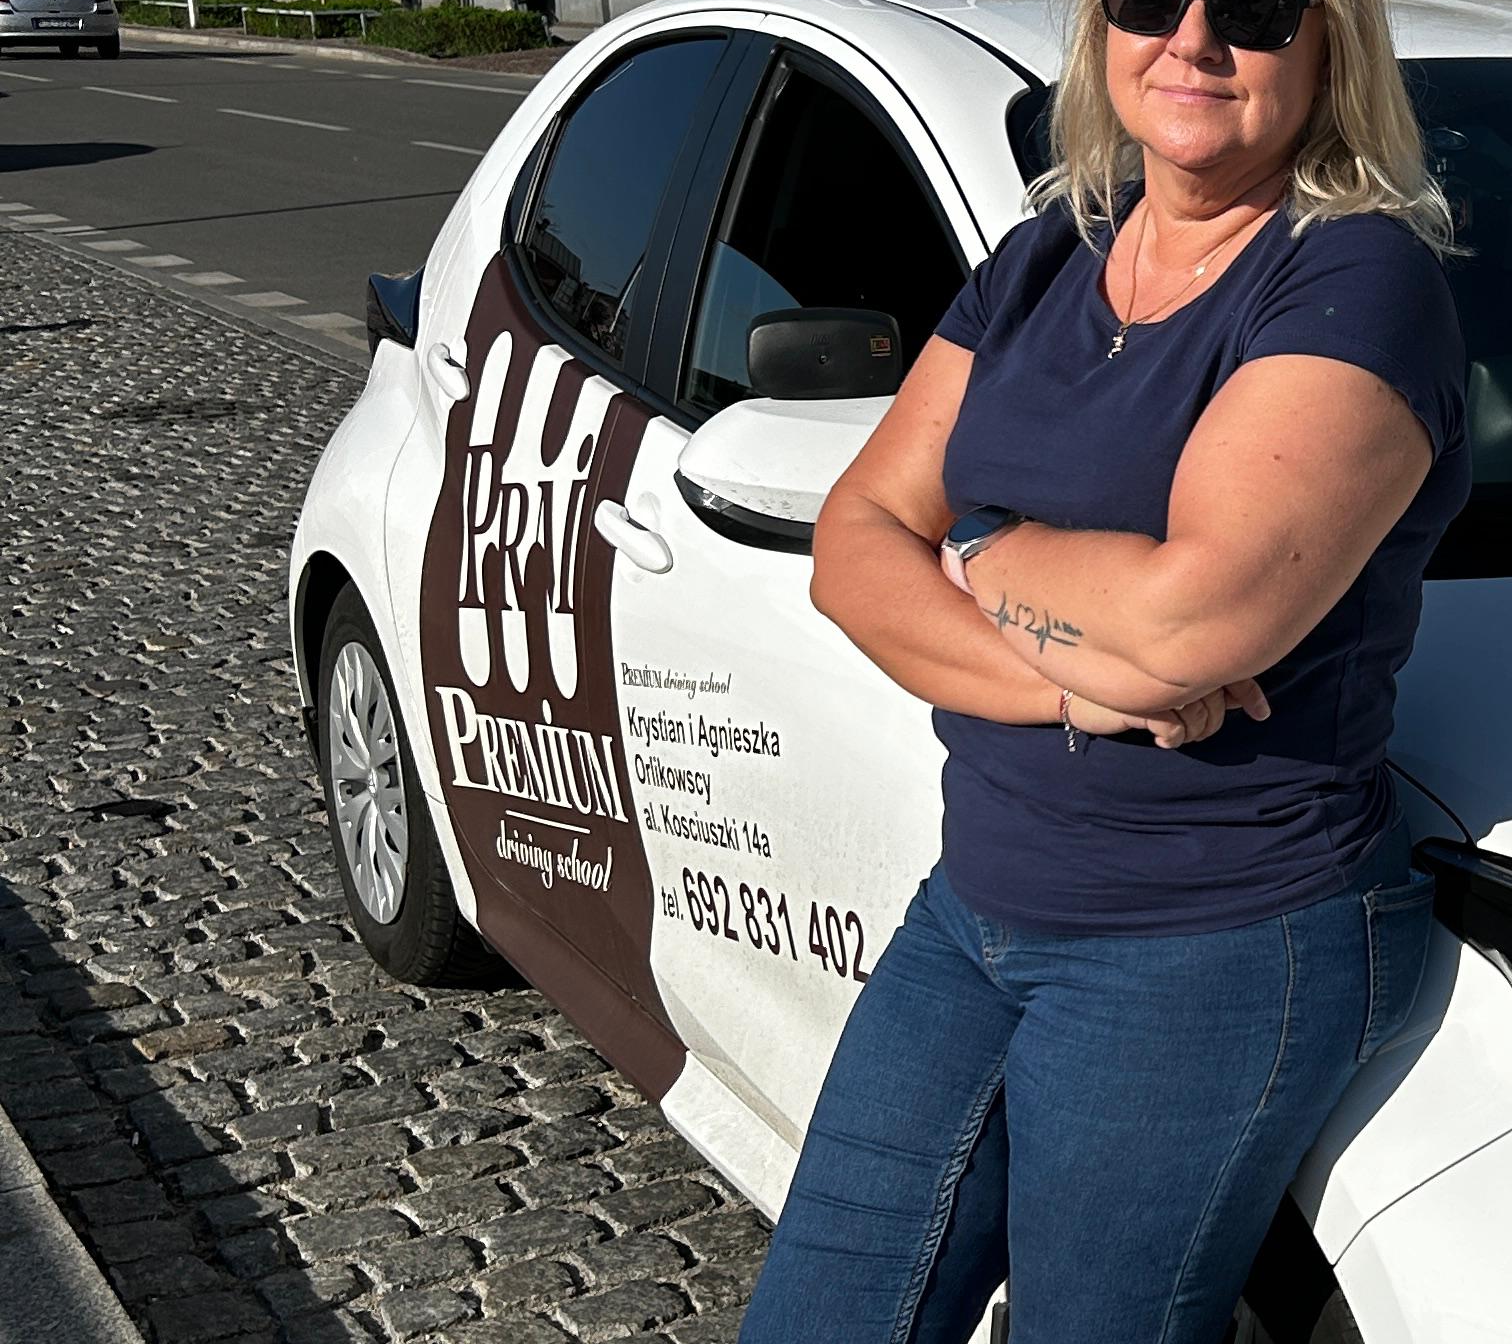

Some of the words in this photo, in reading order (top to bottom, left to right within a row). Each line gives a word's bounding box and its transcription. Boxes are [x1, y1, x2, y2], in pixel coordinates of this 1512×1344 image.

[663, 669, 697, 699] driving
[699, 672, 732, 694] school
[434, 686, 629, 823] PREMIUM
[627, 706, 686, 747] Krystian
[688, 713, 695, 745] i
[698, 715, 781, 757] Agnieszka
[634, 754, 711, 805] Orlikowscy
[496, 819, 554, 889] driving
[556, 838, 613, 892] school
[643, 802, 661, 833] al.
[660, 804, 740, 851] Kosciuszki
[742, 820, 772, 858] 14a
[661, 885, 684, 920] tel.
[682, 867, 740, 942] 692
[739, 882, 798, 961] 831
[809, 901, 871, 984] 402
